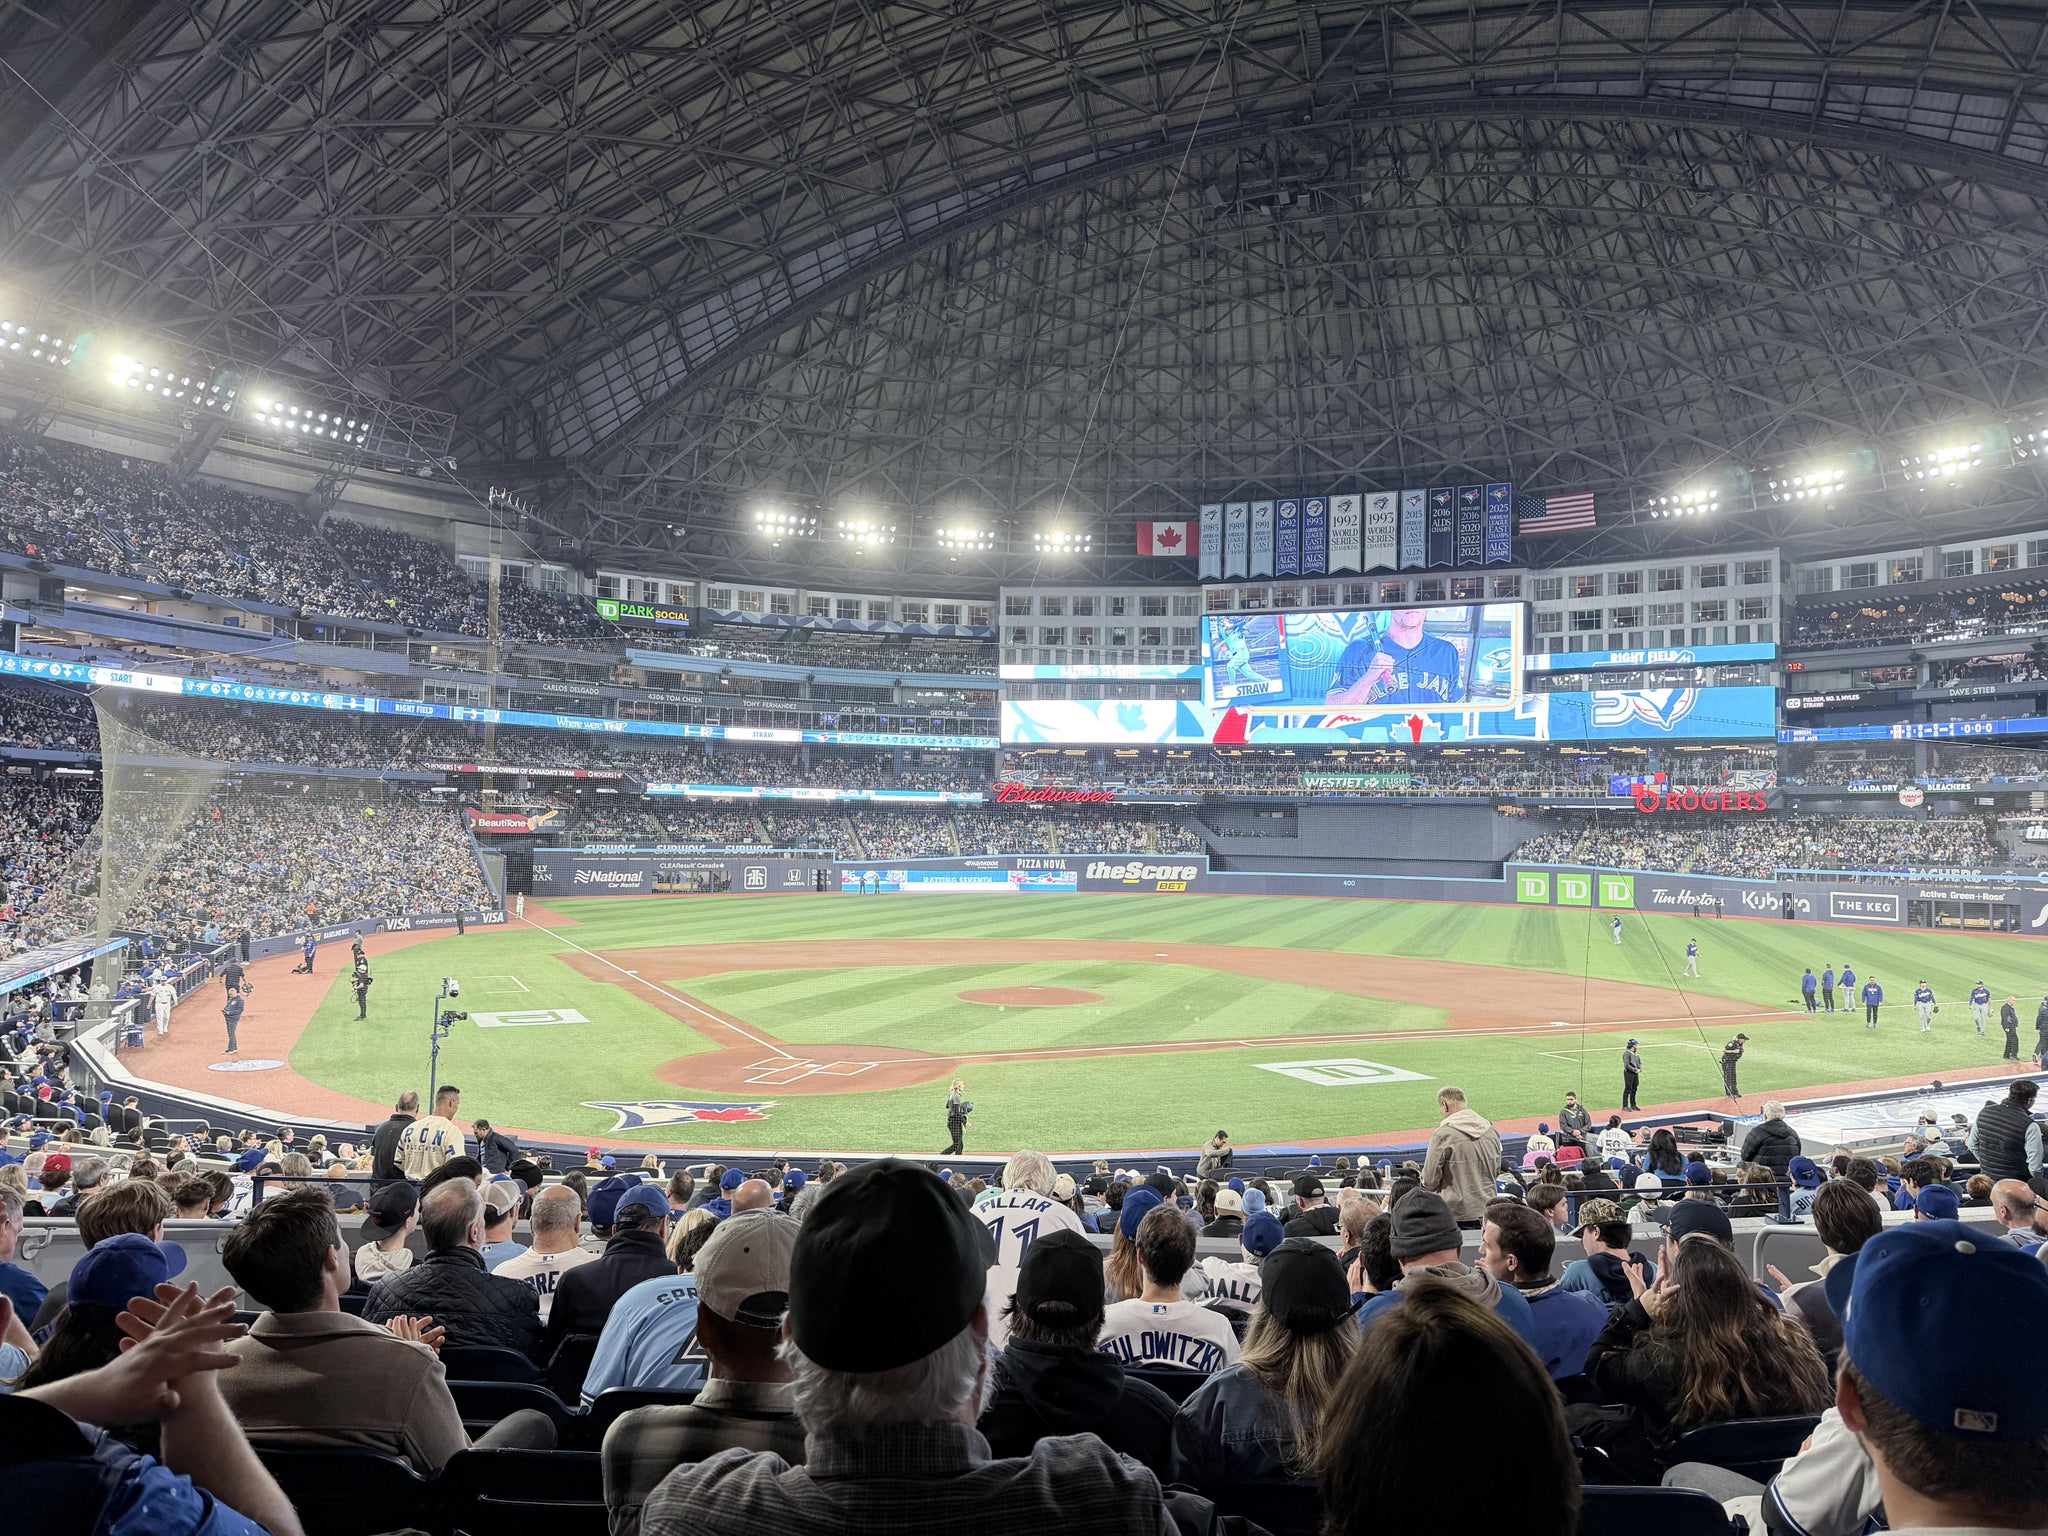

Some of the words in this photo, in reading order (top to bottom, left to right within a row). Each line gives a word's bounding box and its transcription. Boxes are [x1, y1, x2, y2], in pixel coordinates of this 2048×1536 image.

[1433, 508, 1450, 517] 2016
[1490, 504, 1509, 512] 2025
[1369, 512, 1394, 525] 1993
[1405, 510, 1422, 519] 2015
[1462, 512, 1479, 520] 2016
[1255, 521, 1270, 529] 1991
[1280, 519, 1296, 527] 1992
[1307, 517, 1323, 525] 1993
[1333, 515, 1358, 527] 1992
[1203, 524, 1219, 532] 1985
[1368, 526, 1394, 534] WORLD
[1461, 523, 1480, 532] 2020
[1332, 529, 1358, 537] WORLD
[1331, 537, 1358, 545] SERIES
[1367, 534, 1394, 543] SERIES
[1461, 535, 1480, 544] 2022
[1489, 542, 1509, 550] ALCS
[1404, 548, 1423, 556] ALDS
[1461, 548, 1480, 556] 2023
[1279, 555, 1296, 563] ALCS
[1305, 553, 1323, 562] ALCS
[599, 604, 616, 616] TD
[621, 604, 654, 616] PARK
[655, 610, 689, 620] SOCIAL
[1611, 652, 1645, 663] RIGHT
[1650, 651, 1676, 662] FIELD
[543, 684, 567, 692] CARLOS
[570, 686, 599, 695] DELGADO
[1237, 683, 1269, 696] STRAW
[1950, 687, 1970, 696] DAVE
[1972, 686, 1996, 695] STIEB
[395, 704, 415, 713] RIGHT
[417, 705, 434, 714] FIELD
[762, 702, 797, 710] FERNANDEZ
[471, 710, 477, 719] 3
[556, 716, 582, 728] Where
[584, 721, 602, 730] were
[1964, 724, 1971, 733] 0
[1975, 724, 1981, 732] 0
[1986, 723, 1992, 732] 0
[992, 781, 1115, 803] Budweiser
[1666, 791, 1767, 810] ROGERS
[479, 819, 526, 827] BeautiTone
[2026, 826, 2048, 839] th
[1017, 858, 1041, 869] PIZZA
[1044, 859, 1067, 870] NOVA
[1086, 862, 1198, 880] theScore
[590, 871, 643, 882] National
[1521, 878, 1546, 896] TD
[1560, 880, 1587, 898] TD
[1603, 882, 1630, 900] TD
[1652, 889, 1674, 904] Tim
[1920, 890, 1948, 899] Active
[1950, 891, 2004, 901] Green+Ross
[1838, 901, 1862, 910] THE
[1867, 902, 1890, 912] KEG
[415, 918, 442, 926] everywhere
[482, 912, 504, 923] VISA
[385, 918, 410, 930] VISA
[404, 1128, 445, 1146] RON
[1536, 1142, 1547, 1150] 17
[1605, 1140, 1620, 1151] 50
[979, 1197, 1052, 1213] PILLAR
[656, 1287, 699, 1305] SPR
